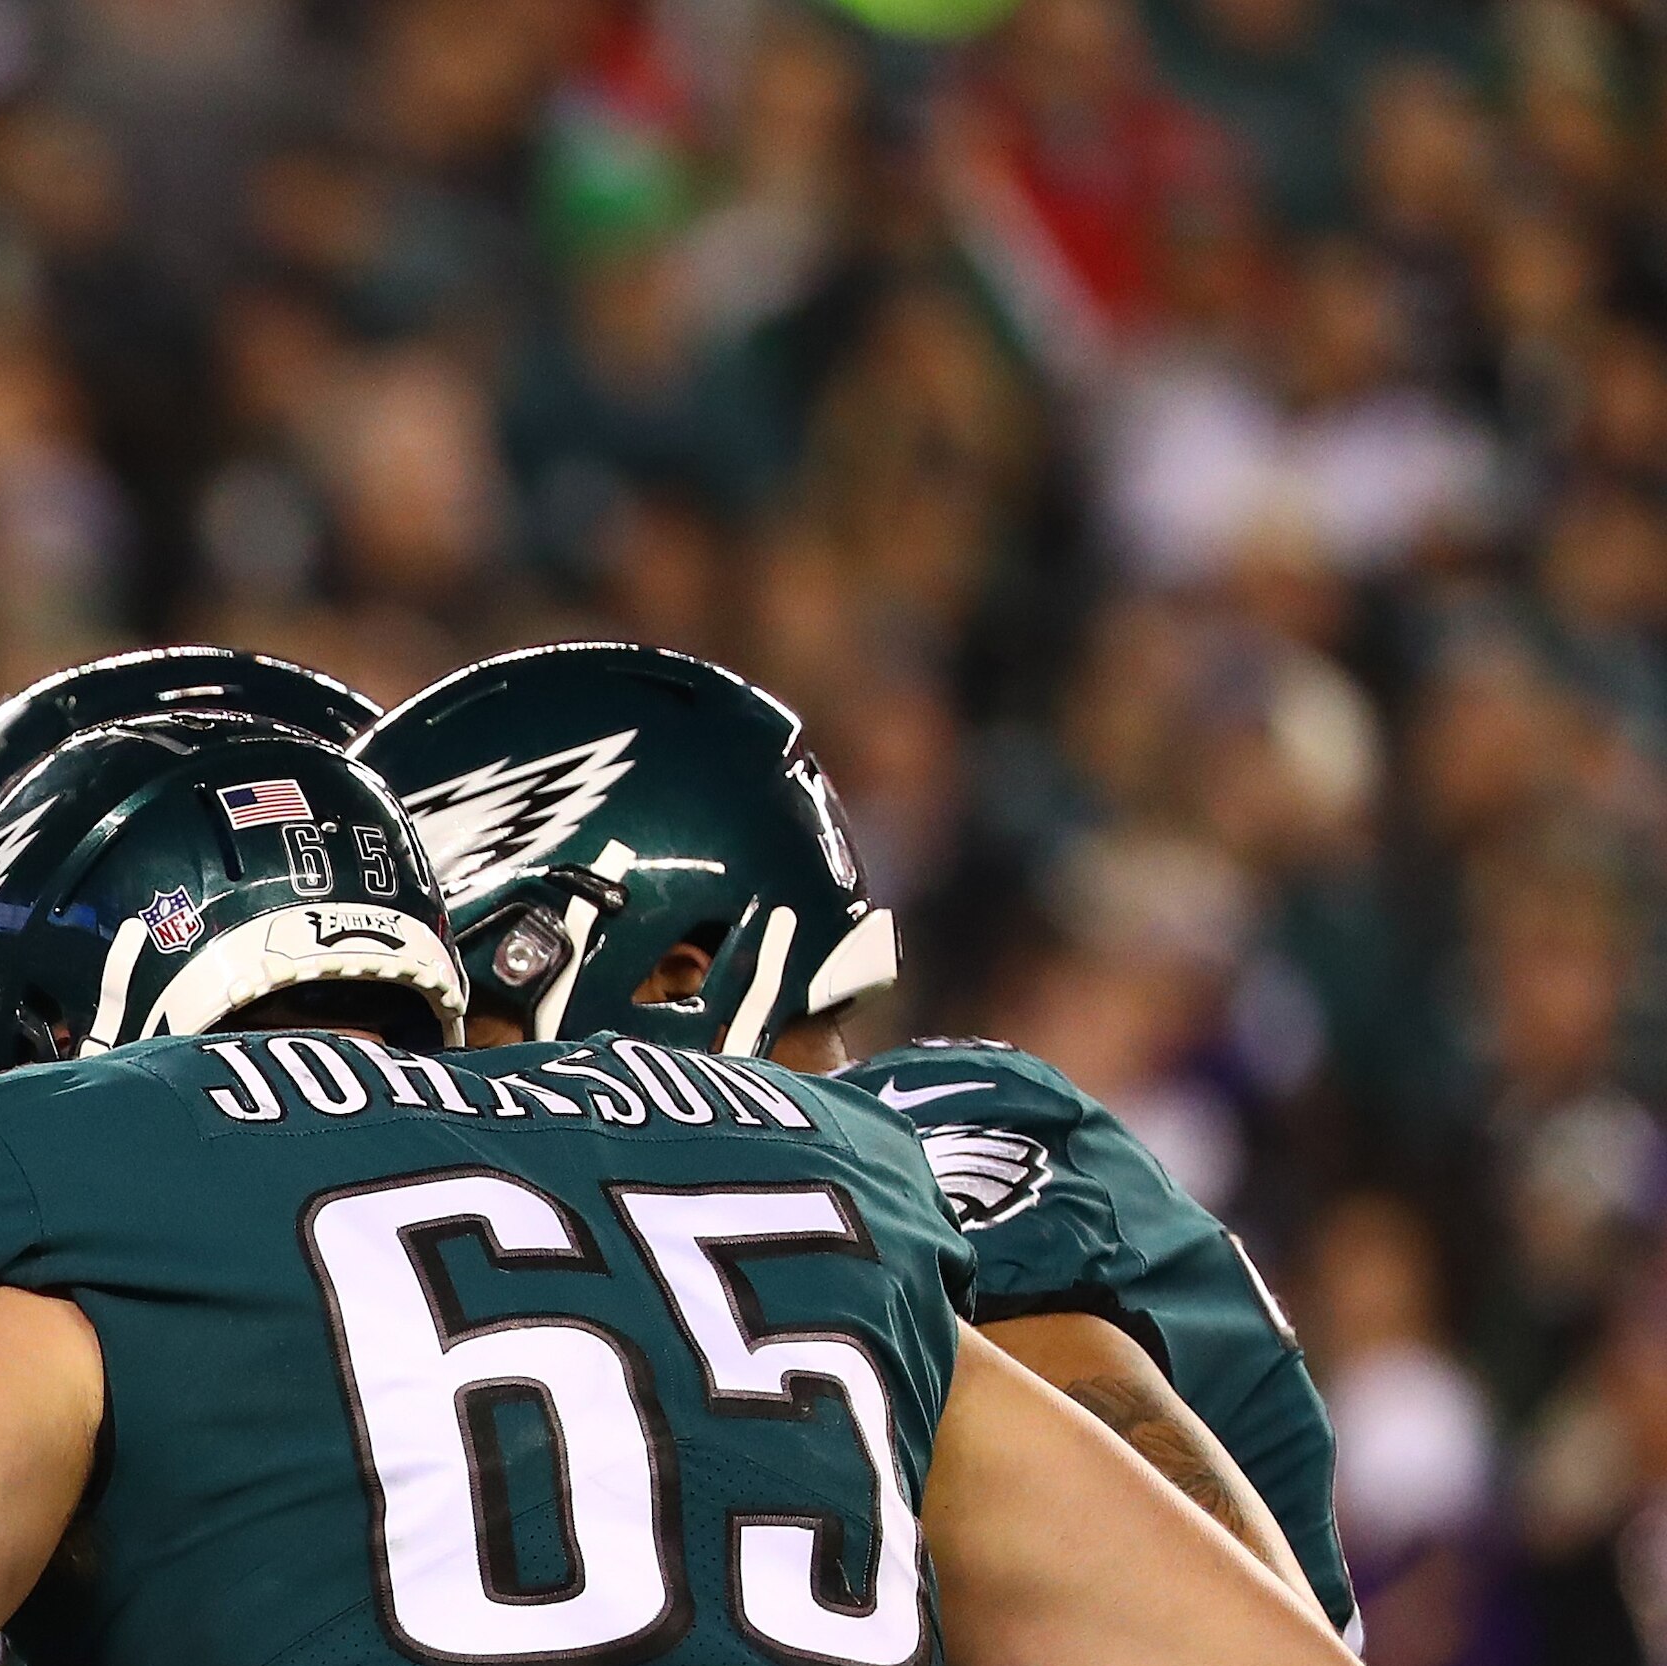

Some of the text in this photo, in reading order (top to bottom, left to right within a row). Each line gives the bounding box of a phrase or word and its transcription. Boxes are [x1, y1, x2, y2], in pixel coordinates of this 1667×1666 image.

[279, 823, 399, 898] 65
[153, 911, 197, 946] NFL
[305, 911, 406, 950] EAGLES
[199, 1035, 815, 1128] JOHNSON
